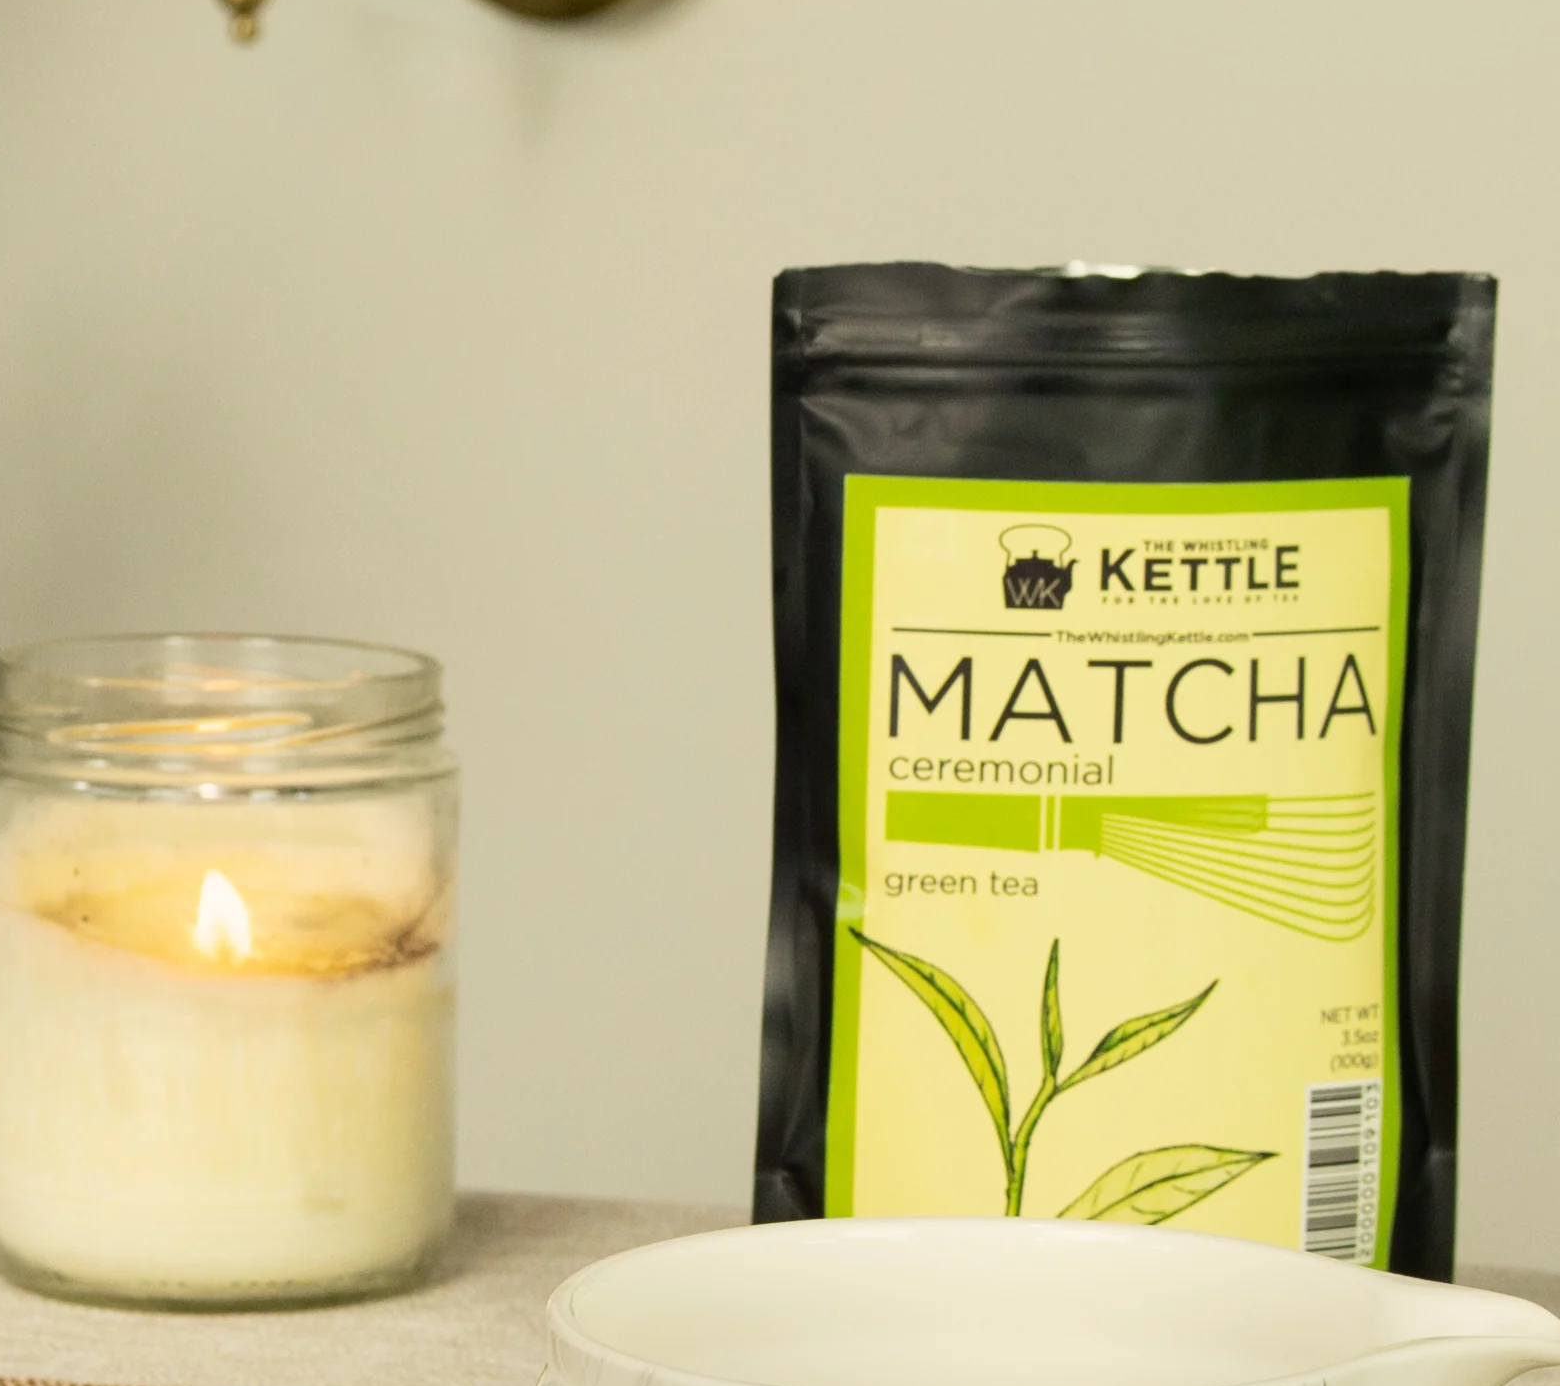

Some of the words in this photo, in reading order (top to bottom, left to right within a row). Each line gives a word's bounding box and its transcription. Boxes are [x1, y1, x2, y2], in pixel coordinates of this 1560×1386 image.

[1144, 540, 1175, 553] THE
[1182, 538, 1270, 552] WHISTLING
[1100, 545, 1300, 592] KETTLE
[1056, 629, 1250, 646] TheWhistlingKettle.com
[889, 653, 1377, 745] MATCHA
[889, 754, 1115, 785] ceremonial
[885, 870, 977, 897] green
[990, 871, 1039, 896] tea
[1320, 1007, 1351, 1025] NET
[1356, 1002, 1380, 1021] WT
